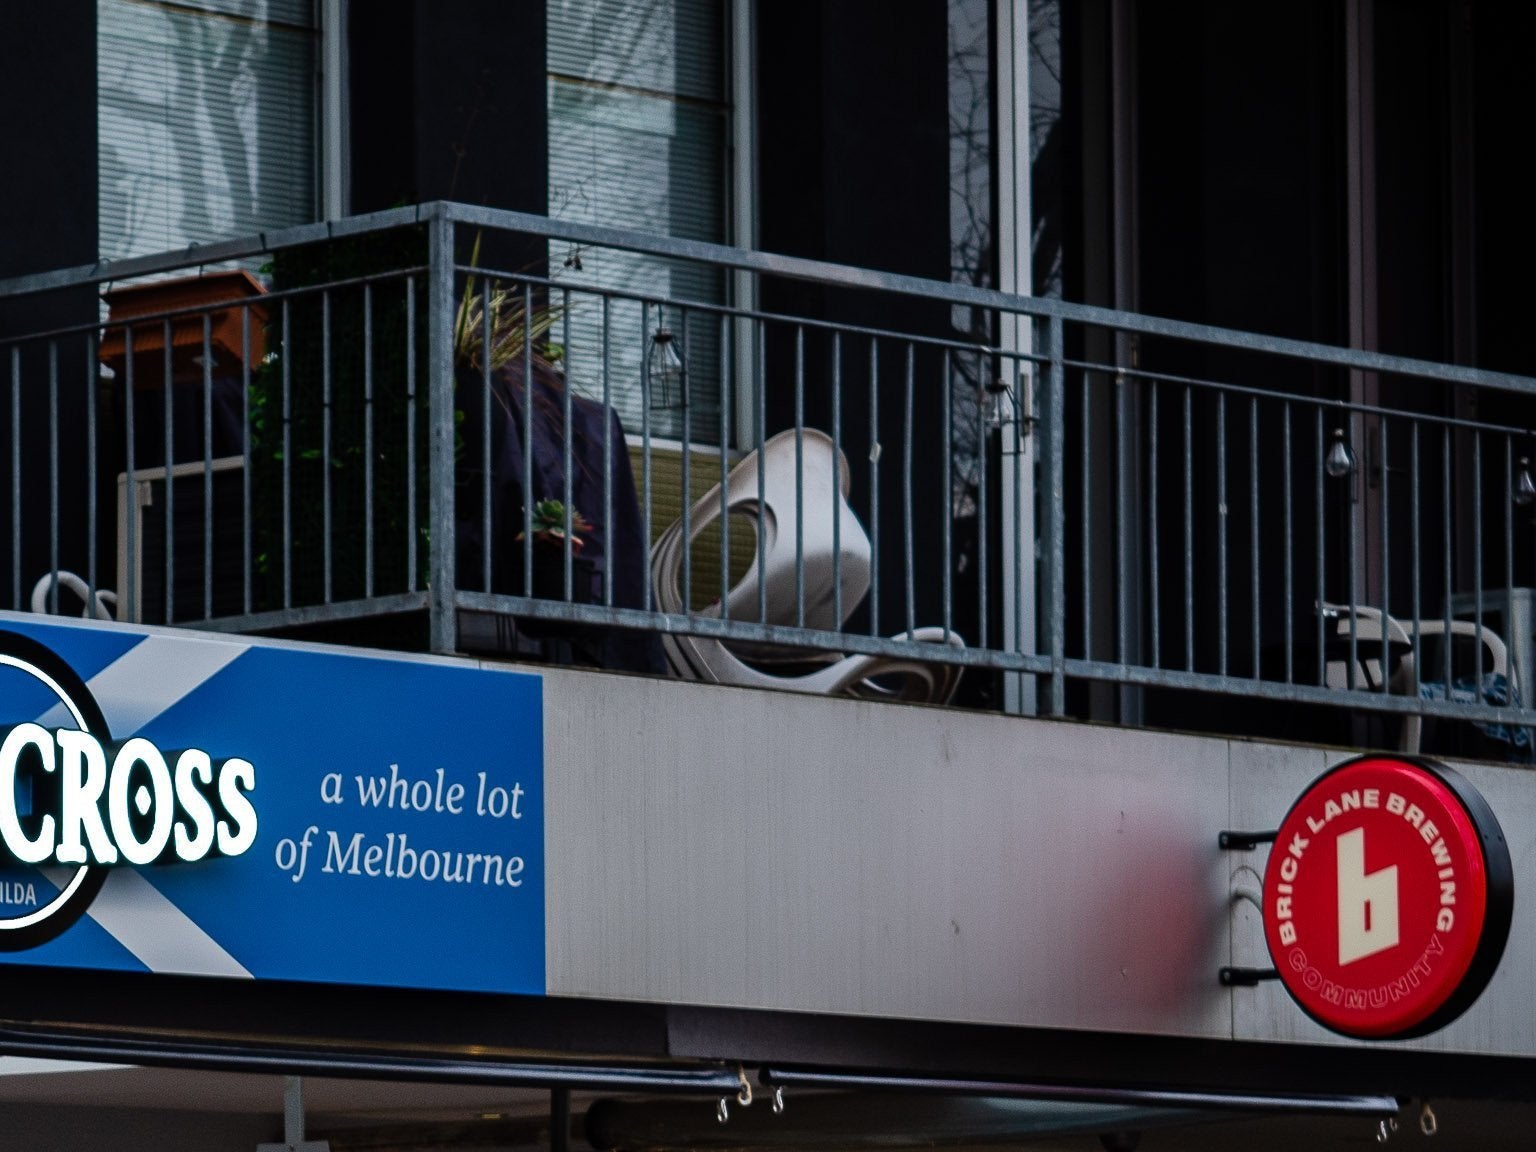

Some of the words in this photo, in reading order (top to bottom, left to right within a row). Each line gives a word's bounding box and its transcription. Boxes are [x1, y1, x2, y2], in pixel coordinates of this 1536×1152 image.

[320, 772, 344, 804] a
[355, 763, 465, 815] whole
[476, 771, 525, 820] lot
[275, 825, 319, 883] of
[321, 830, 525, 888] Melbourne
[1276, 832, 1310, 947] BRICK
[1305, 788, 1380, 834] LANE
[1385, 792, 1456, 933] BREWING
[1289, 933, 1444, 1009] COMMUNITY
